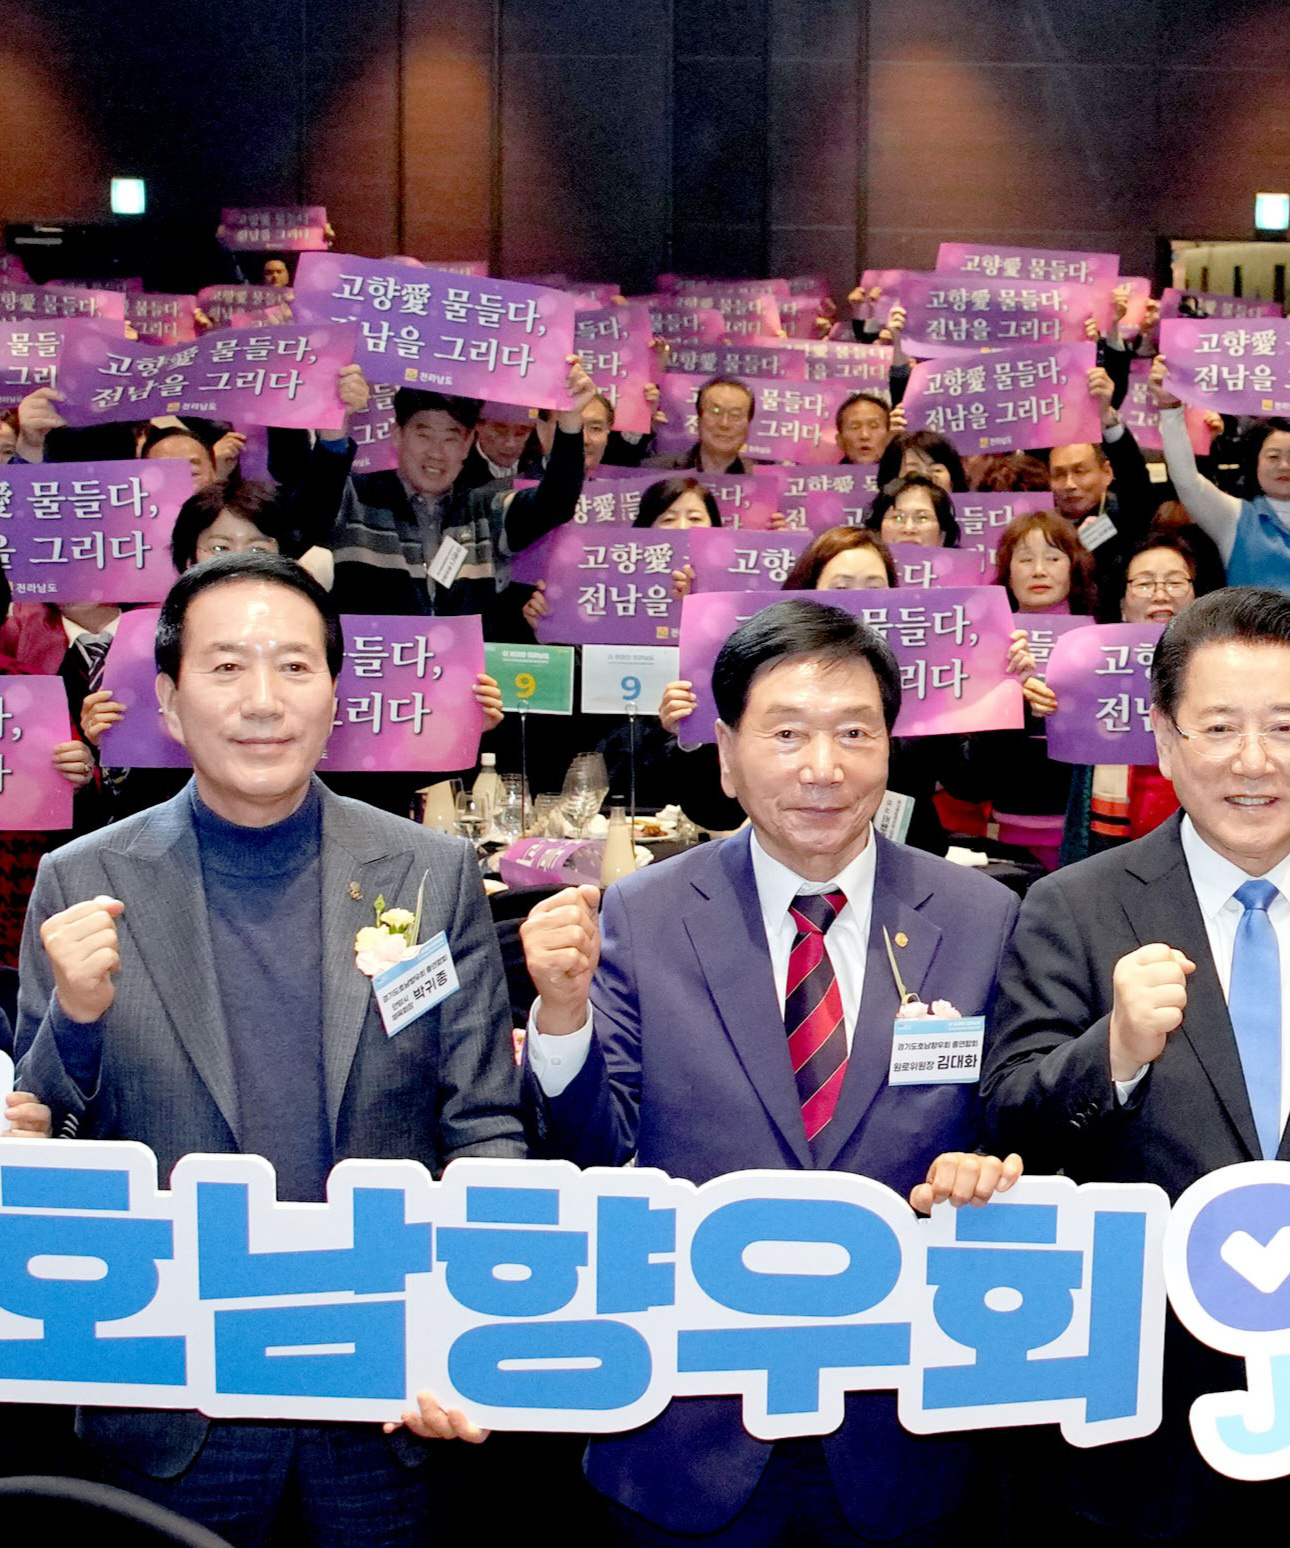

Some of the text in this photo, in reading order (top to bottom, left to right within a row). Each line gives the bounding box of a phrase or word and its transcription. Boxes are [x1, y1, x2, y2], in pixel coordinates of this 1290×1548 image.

[331, 272, 432, 317] 고향愛
[441, 288, 547, 337] 물들다,
[98, 335, 319, 379] 고향愛 물들다,
[331, 316, 535, 378] 남을 그리다
[1194, 327, 1277, 359] 고향愛
[91, 368, 305, 409] 전남을 그리다
[922, 356, 1068, 398] 고향愛 물들다,
[1194, 363, 1277, 394] 전남을
[757, 419, 823, 447] 그리다
[925, 394, 1064, 435] 전남을 그리다
[26, 476, 159, 519] 물들다,
[28, 530, 152, 570] 그리다
[577, 542, 674, 576] 고향愛
[15, 583, 59, 594] 전라남도
[577, 583, 673, 618] 전남을
[861, 604, 979, 648] 물들다,
[515, 673, 537, 699] 9
[620, 675, 642, 701] 9
[331, 691, 432, 736] 리다
[412, 969, 449, 1002] 박귀종
[893, 1054, 978, 1073] 원로위원장 김대화
[0, 1166, 1148, 1424] 호남향우회
